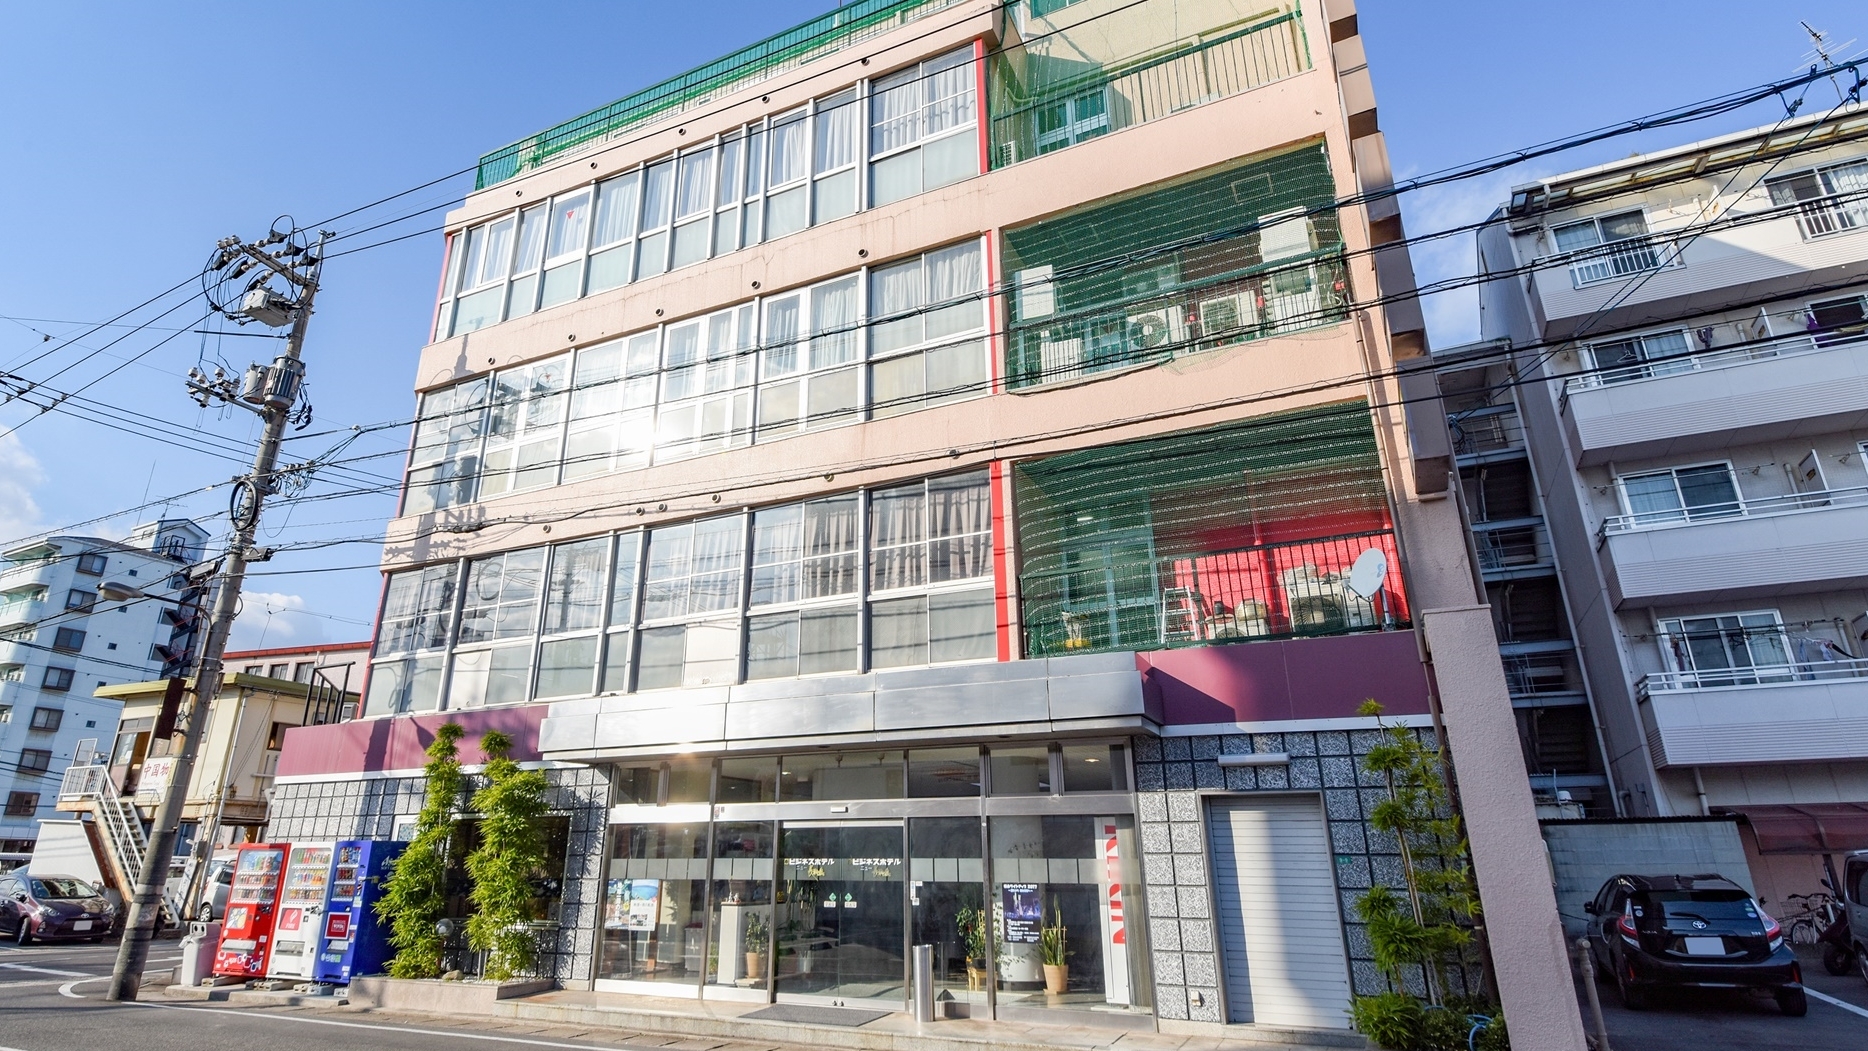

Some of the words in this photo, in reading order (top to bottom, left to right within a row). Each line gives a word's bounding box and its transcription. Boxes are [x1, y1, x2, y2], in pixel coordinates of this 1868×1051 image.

[852, 858, 901, 866] ビジネスホテル
